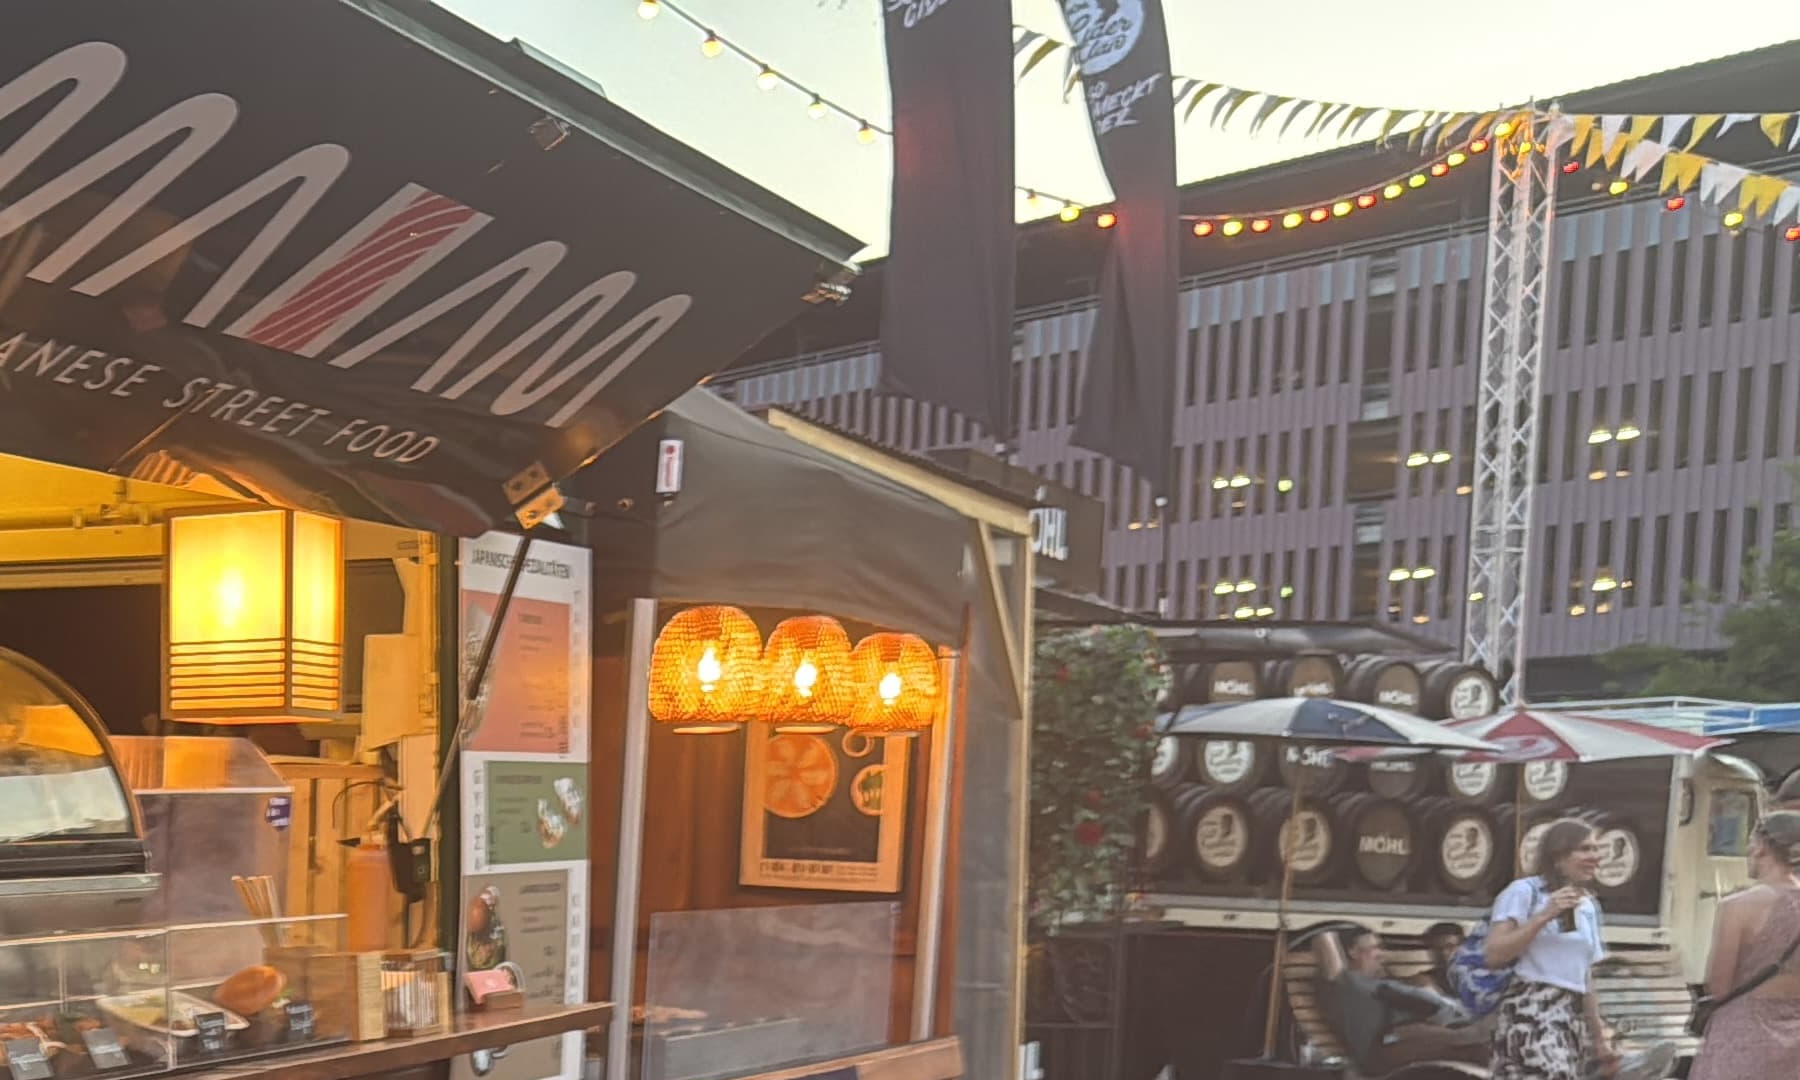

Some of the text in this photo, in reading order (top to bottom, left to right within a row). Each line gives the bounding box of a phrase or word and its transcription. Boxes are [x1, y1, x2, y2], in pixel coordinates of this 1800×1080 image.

[162, 376, 331, 436] STREET
[323, 417, 442, 464] FOOD
[1029, 485, 1068, 561] ÖHL
